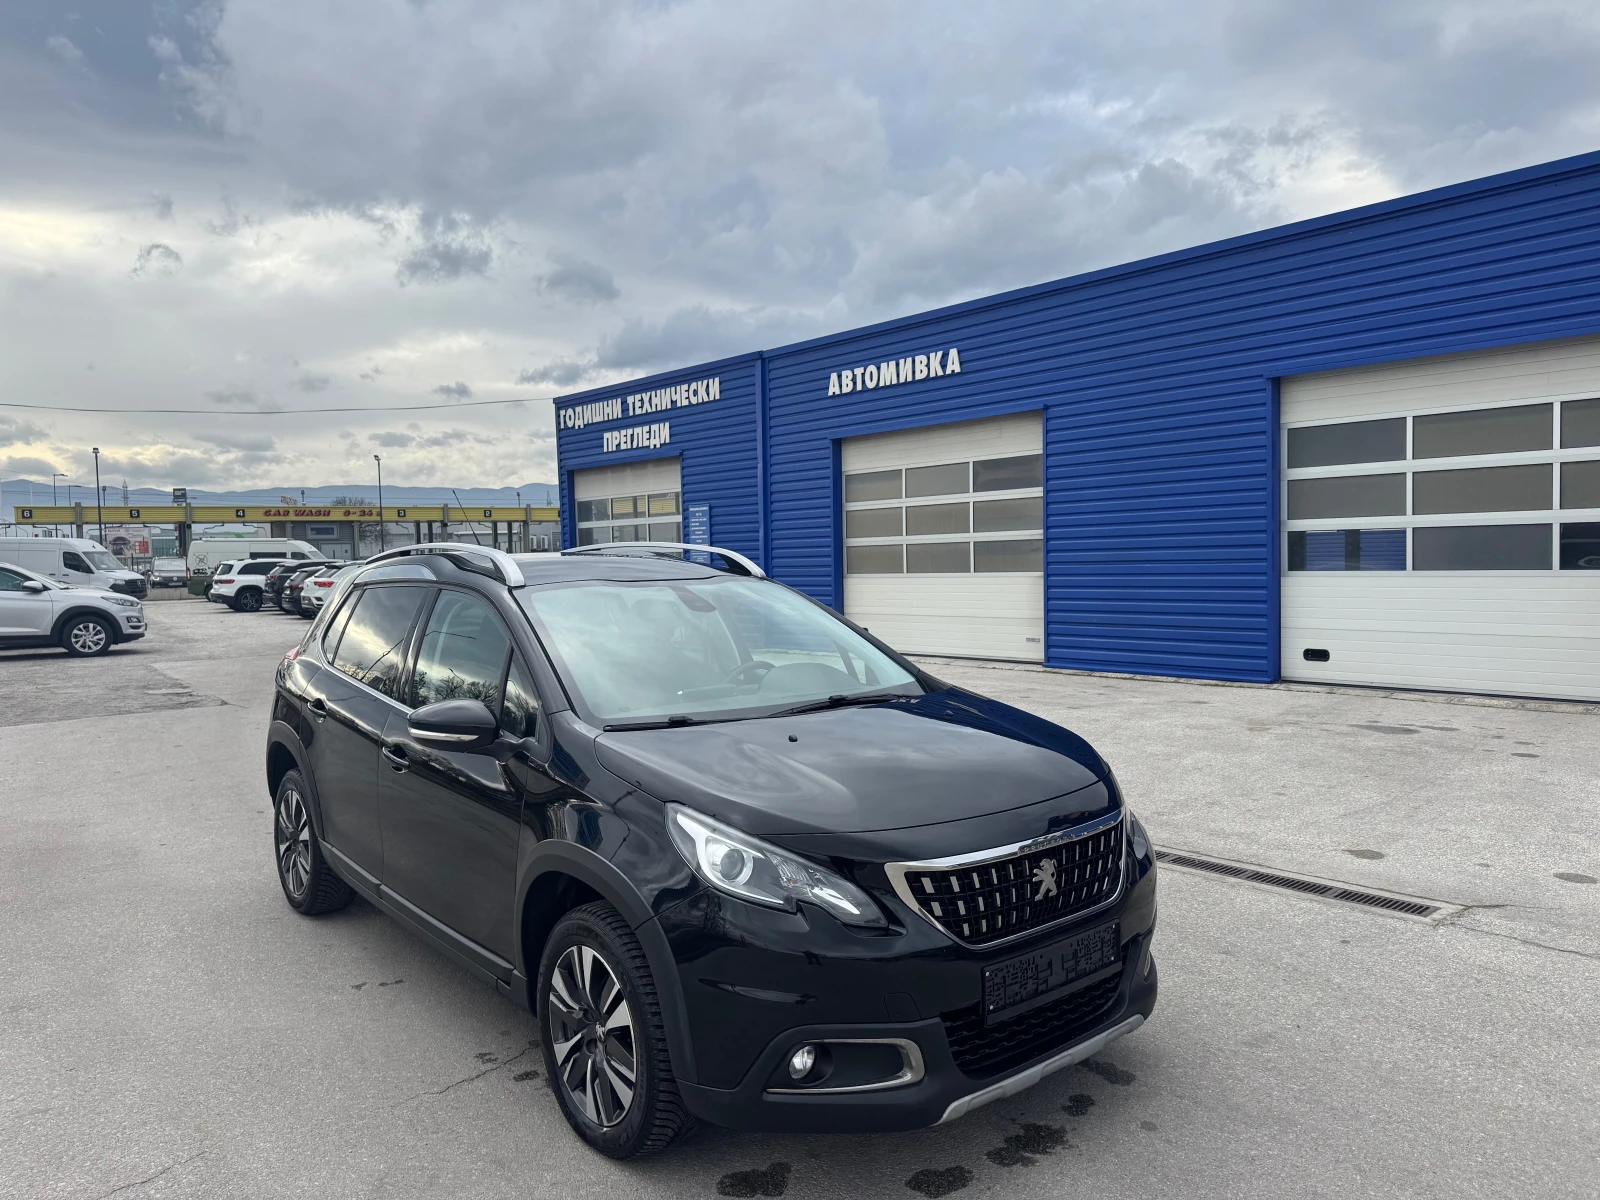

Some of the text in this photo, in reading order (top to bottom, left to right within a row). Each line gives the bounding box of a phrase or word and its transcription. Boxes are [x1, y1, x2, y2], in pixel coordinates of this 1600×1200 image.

[827, 347, 961, 396] АВТОМИВКА
[559, 377, 721, 430] ГОДИШНИ ТЕХНИЧЕСКИ
[603, 422, 671, 452] ПРЕГЛЕДИ
[263, 509, 290, 517] CAR
[294, 509, 331, 517] WASH
